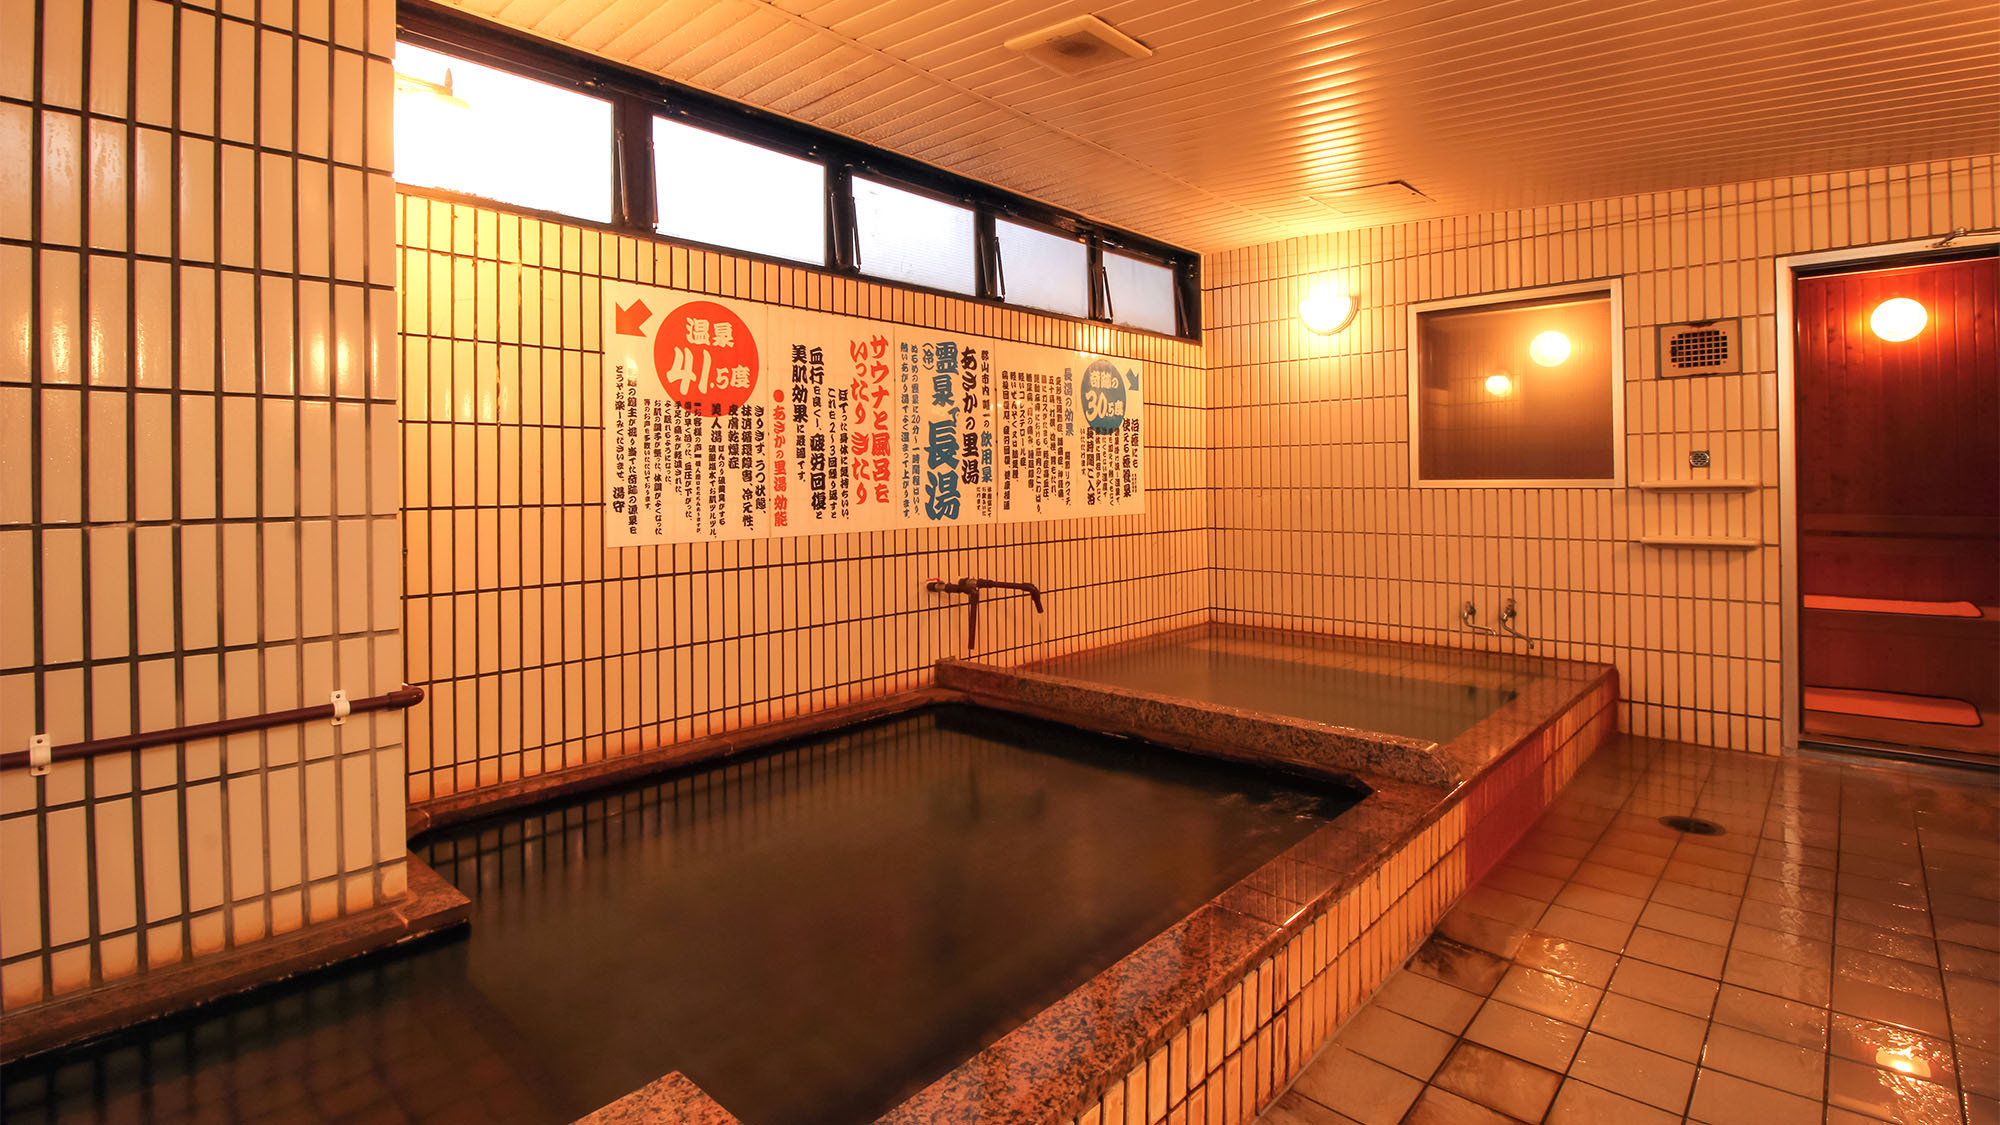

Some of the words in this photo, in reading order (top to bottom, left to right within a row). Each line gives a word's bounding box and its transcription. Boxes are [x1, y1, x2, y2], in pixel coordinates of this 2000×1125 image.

[686, 317, 735, 348] 温泉
[666, 346, 751, 395] 41.5度
[711, 403, 722, 443] 美人湯
[792, 344, 808, 482] 美肌効果に最適です。
[870, 334, 890, 503] サウナと風呂を
[960, 346, 979, 484] あさかの里湯
[1085, 390, 1123, 422] 30.5度
[728, 404, 740, 469] 皮膚乾燥症
[613, 486, 625, 513] 湯守
